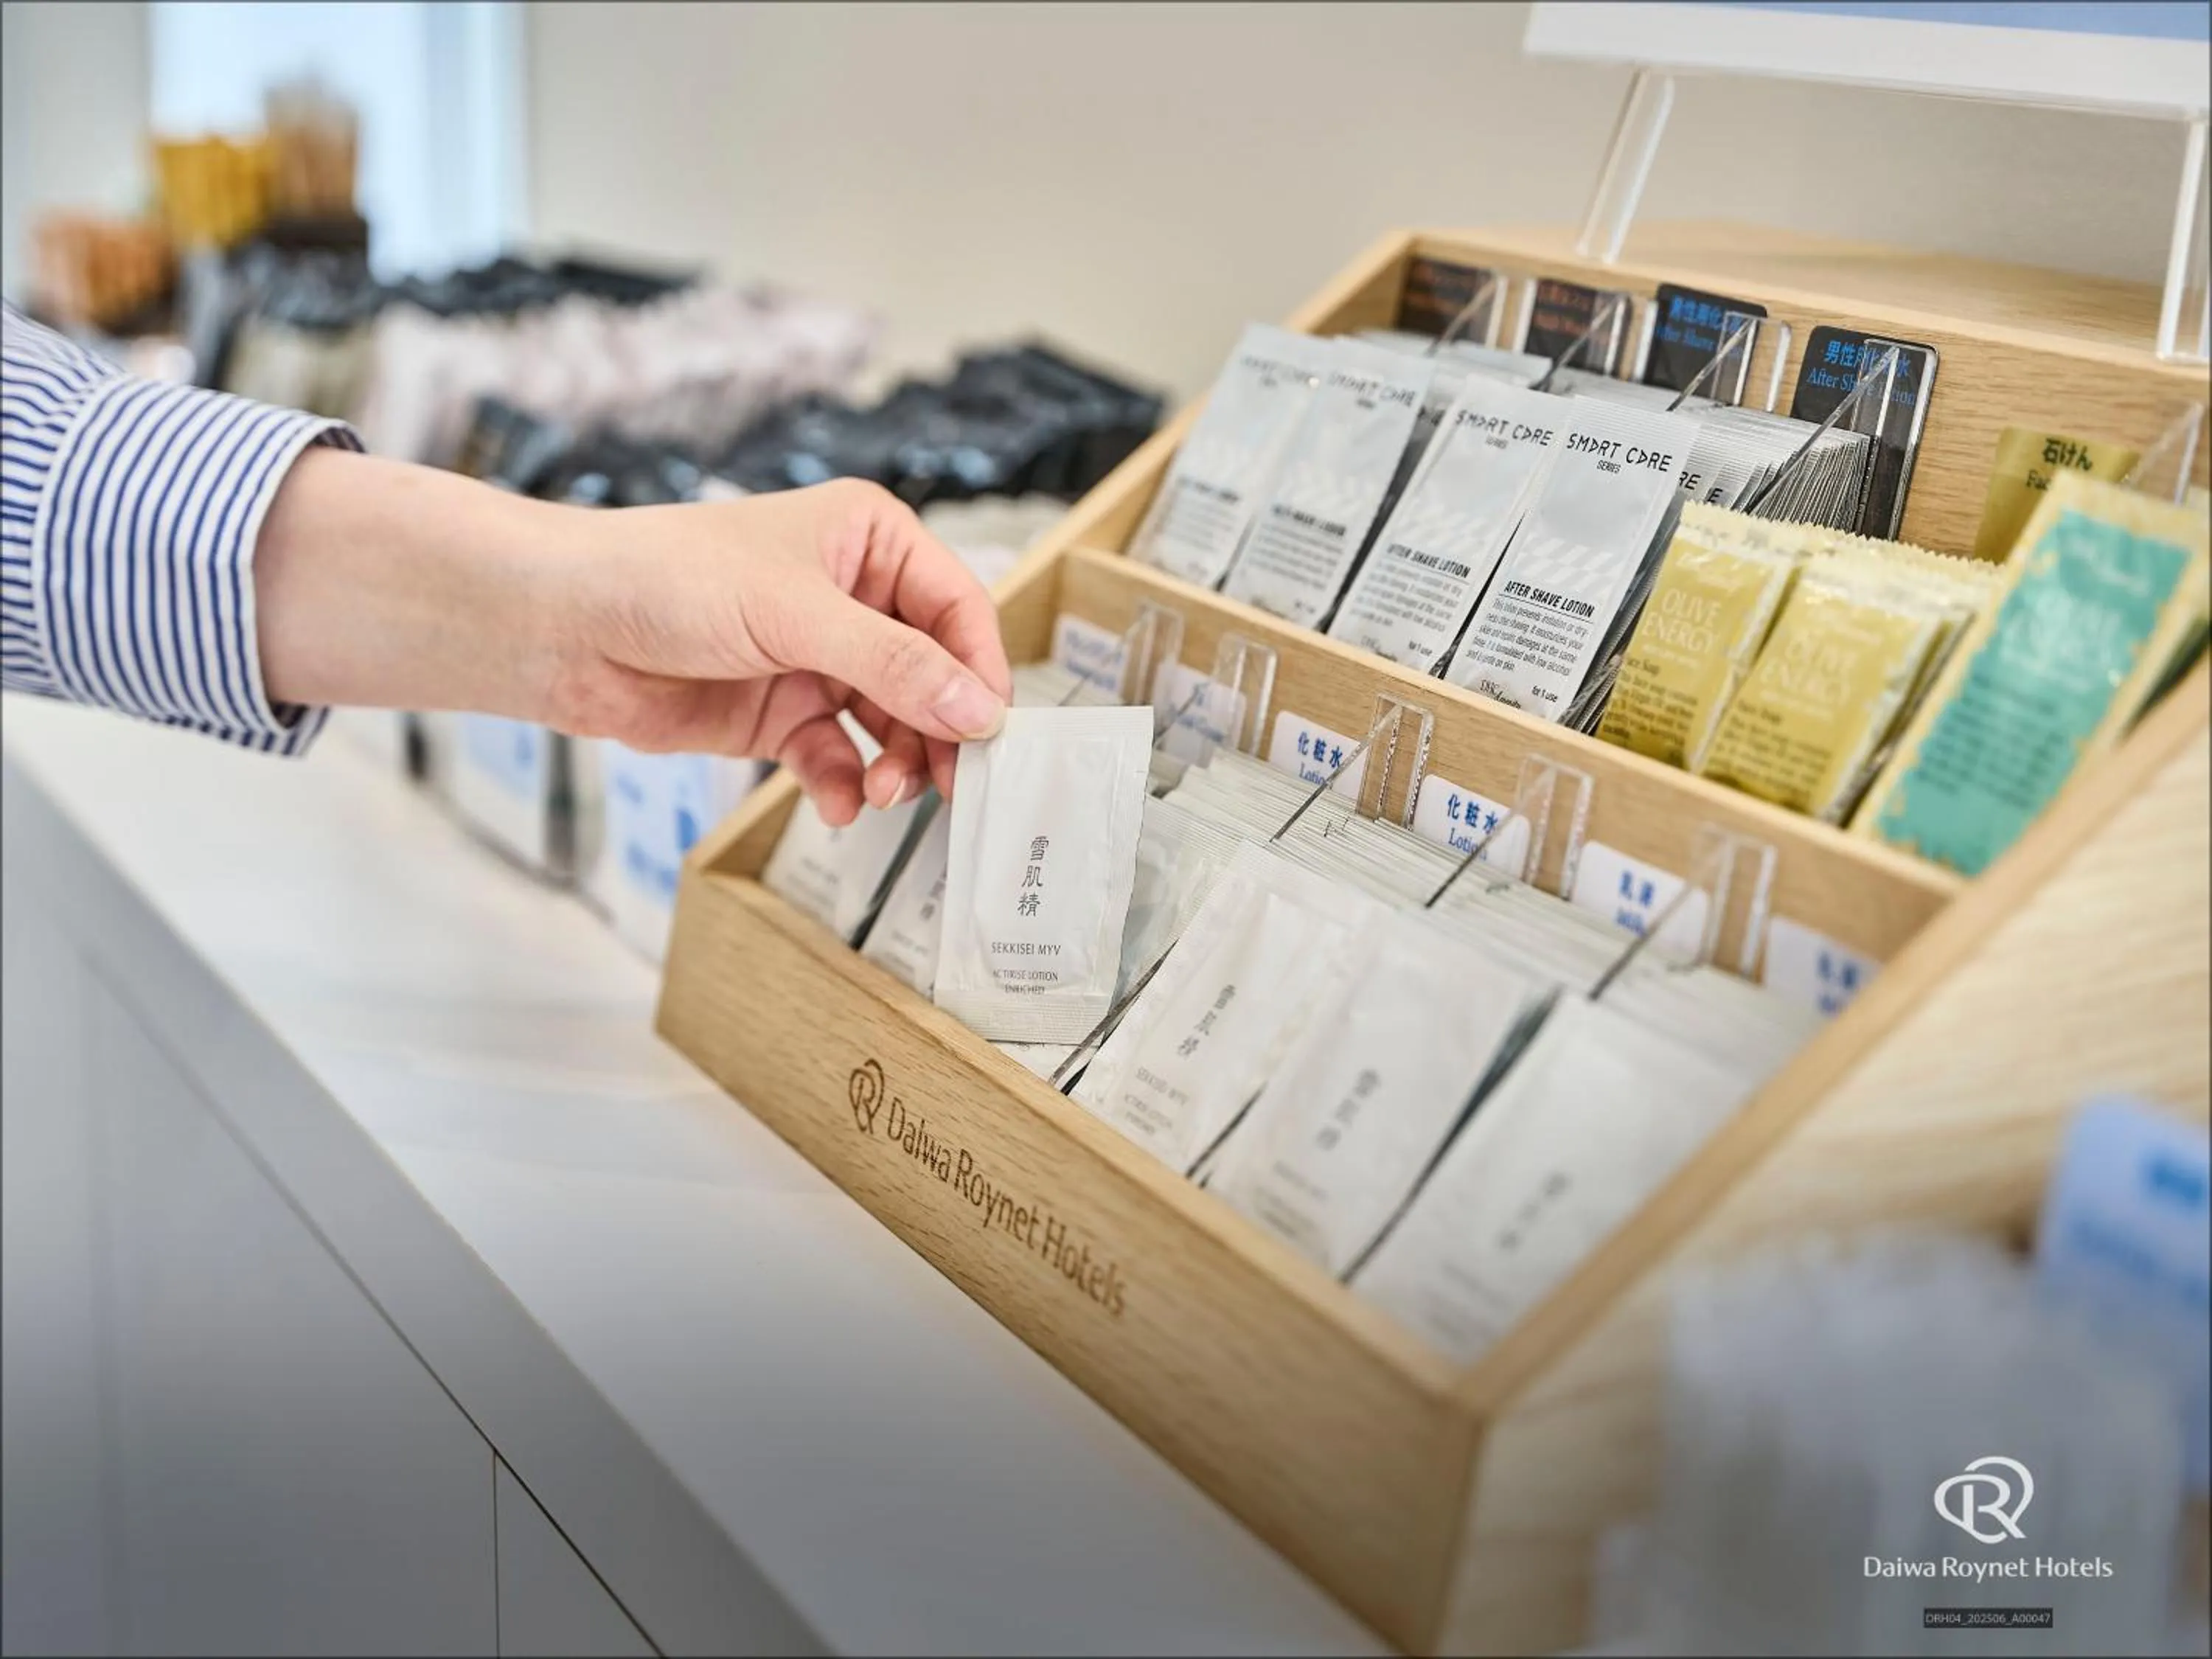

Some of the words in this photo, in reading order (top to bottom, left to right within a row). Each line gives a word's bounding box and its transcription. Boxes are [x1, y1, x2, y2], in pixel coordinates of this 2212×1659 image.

[1806, 366, 1840, 389] After
[1625, 447, 1672, 473] CARE
[2042, 437, 2093, 471] 石けん
[1503, 580, 1531, 598] AFTER
[1530, 588, 1562, 608] SHAVE
[1560, 597, 1596, 619] LOTION
[1662, 588, 1722, 628] OLIVE
[1298, 731, 1343, 768] 化粧水
[1447, 793, 1498, 835] 化粧水
[1017, 835, 1050, 917] 雪肌精
[991, 942, 1034, 956] SEKKISEI
[1037, 944, 1062, 956] MYV
[887, 1096, 952, 1183] Daiwa
[954, 1149, 1042, 1251] Roynet
[1040, 1216, 1128, 1316] Hotels
